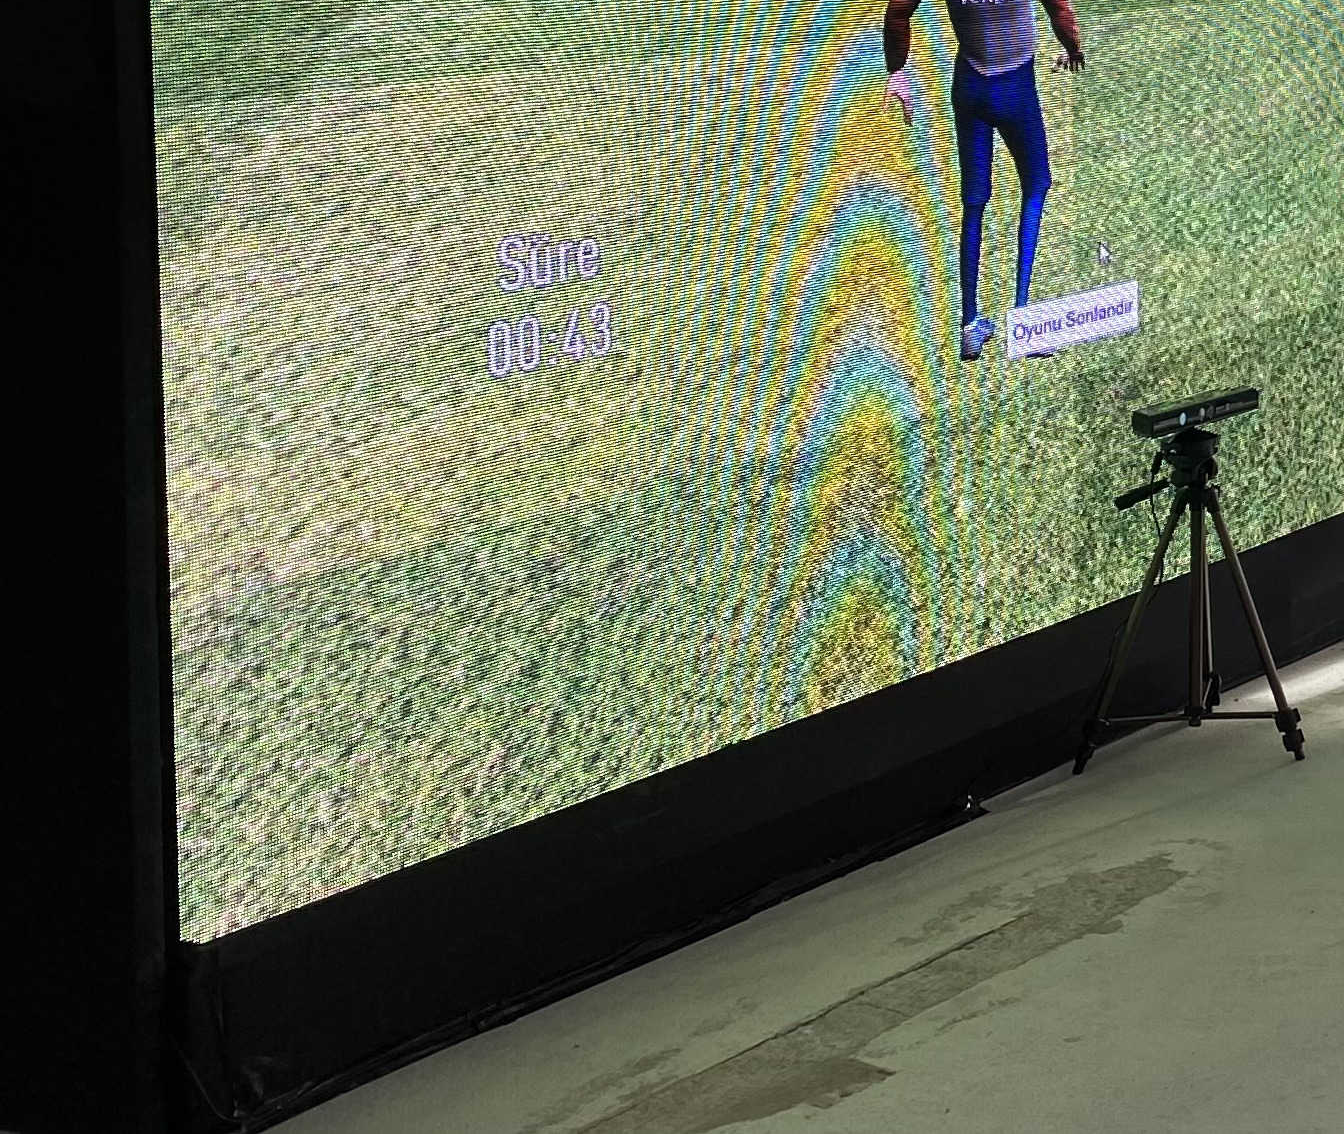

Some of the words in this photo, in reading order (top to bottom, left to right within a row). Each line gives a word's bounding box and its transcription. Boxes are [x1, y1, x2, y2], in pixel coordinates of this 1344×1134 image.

[498, 230, 603, 293] Süre
[487, 299, 612, 379] 00:43
[1013, 319, 1062, 343] Oyunu
